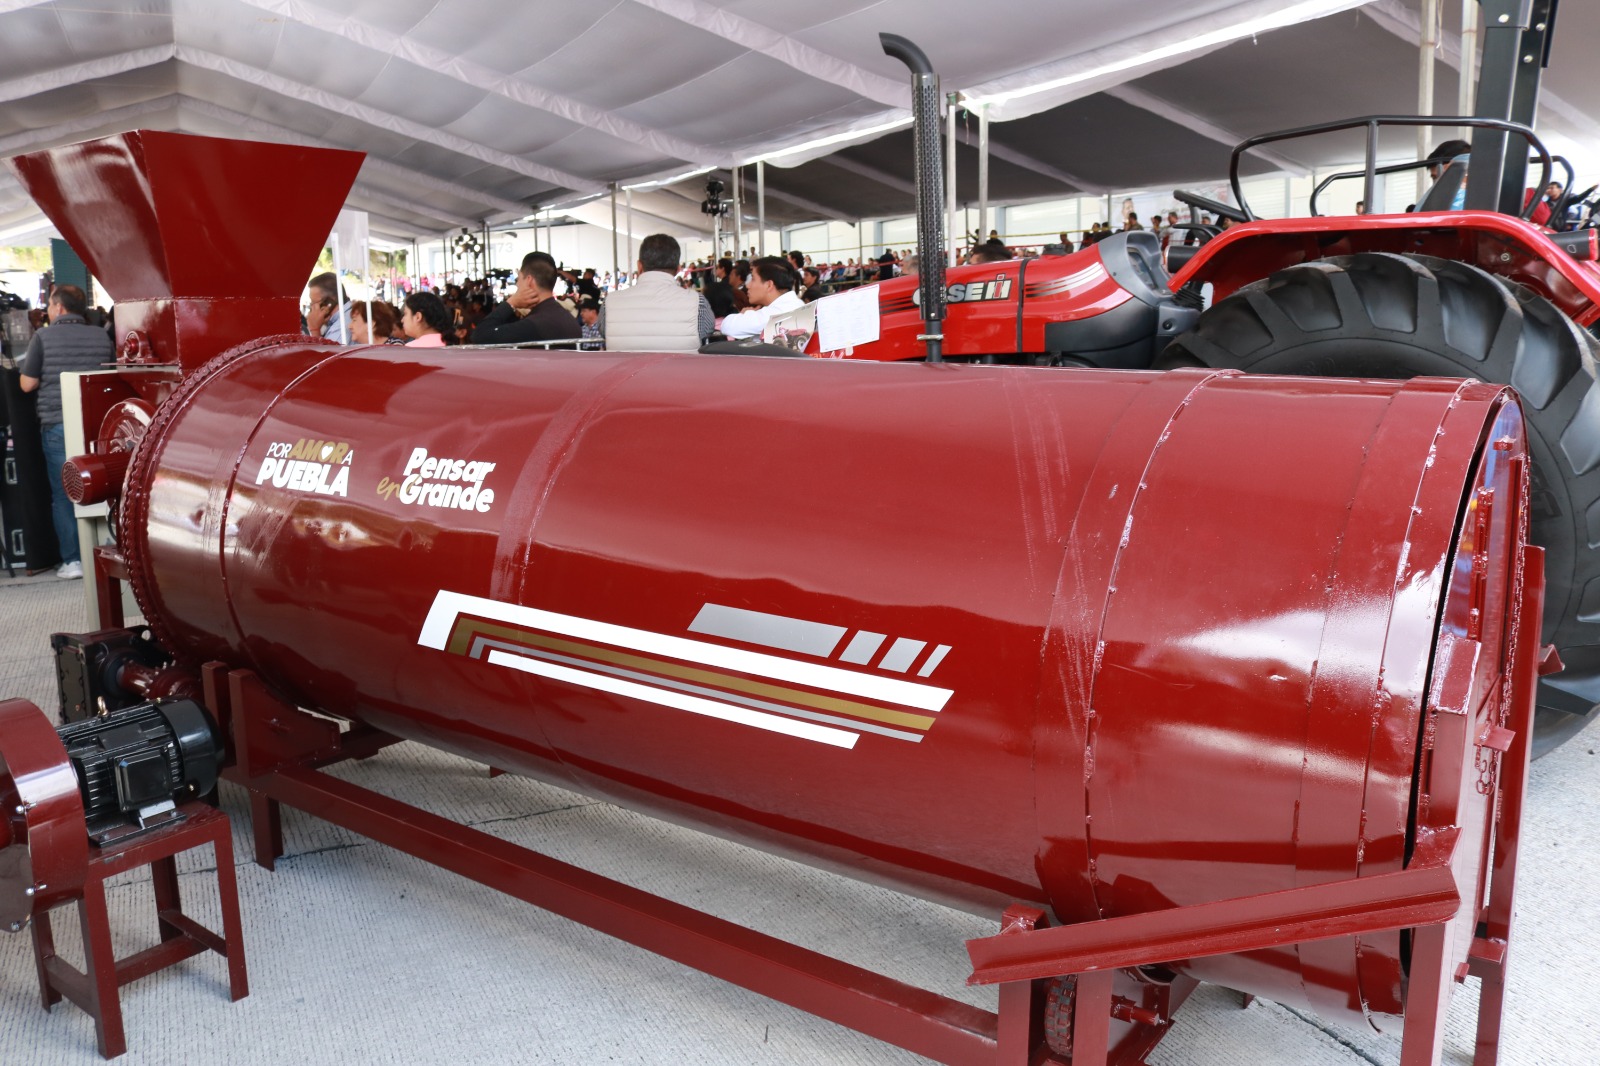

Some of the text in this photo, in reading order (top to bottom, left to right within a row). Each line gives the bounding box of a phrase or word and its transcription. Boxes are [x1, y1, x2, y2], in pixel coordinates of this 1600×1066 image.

[266, 439, 354, 465] POR AMOR A
[403, 447, 496, 482] Pensar
[255, 457, 350, 497] PUEBLA
[377, 474, 495, 513] en Grande
